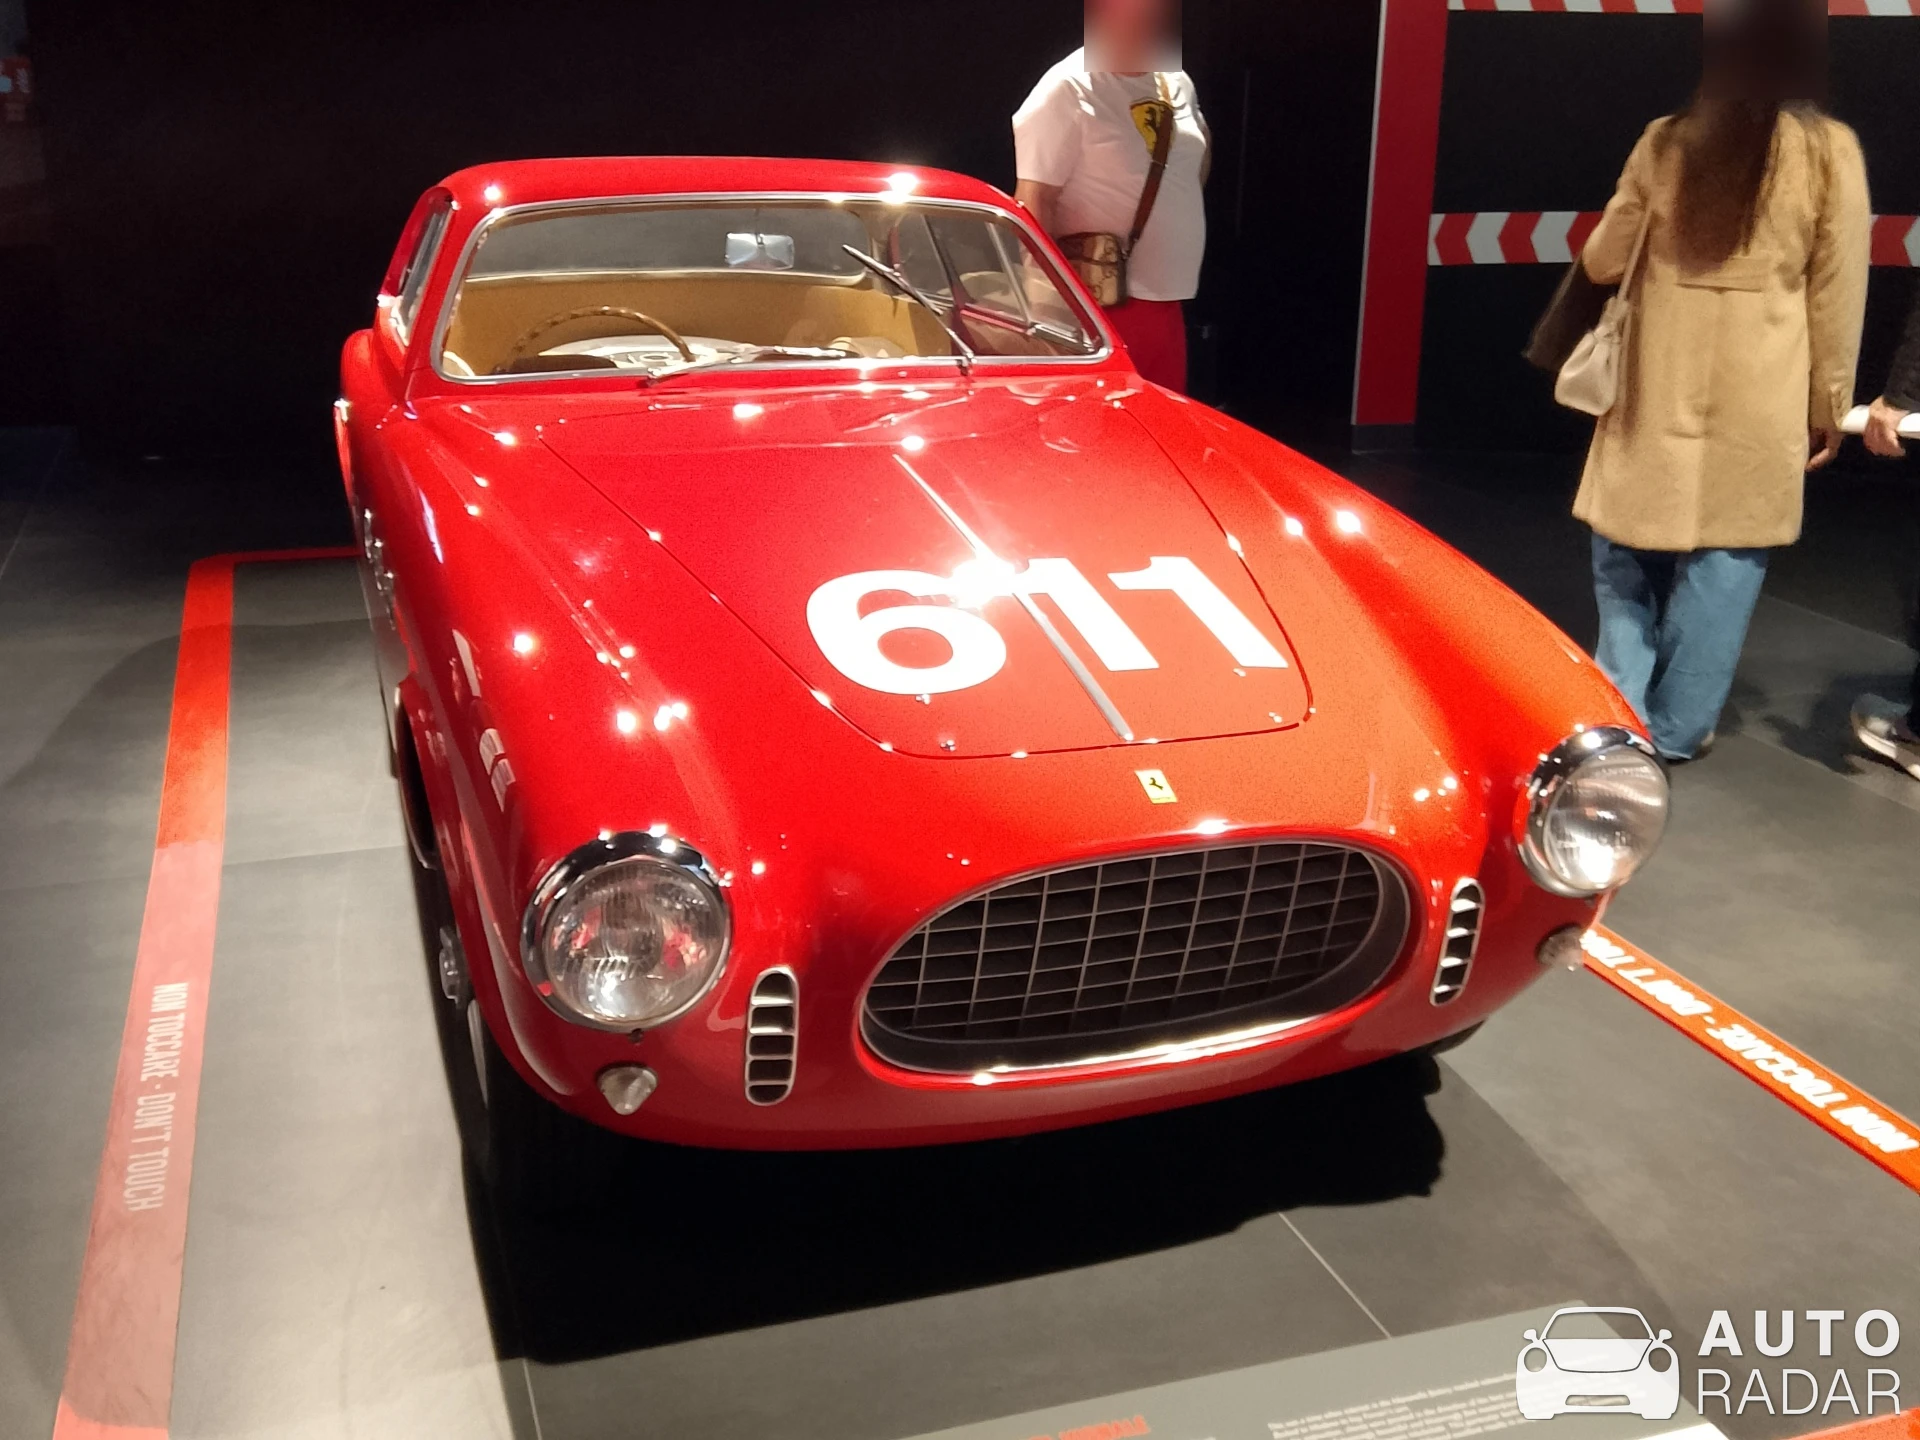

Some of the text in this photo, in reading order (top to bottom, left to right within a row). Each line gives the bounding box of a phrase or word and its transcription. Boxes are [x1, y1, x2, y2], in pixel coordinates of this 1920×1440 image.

[806, 556, 1288, 695] 611
[151, 982, 188, 1013] NON
[1617, 968, 1713, 1016] DON'T
[140, 1013, 185, 1082] TOCCARE
[1706, 1023, 1848, 1109] TOCCARE
[131, 1092, 176, 1143] DON'T
[1829, 1105, 1919, 1153] NON
[123, 1147, 169, 1211] TOUCH
